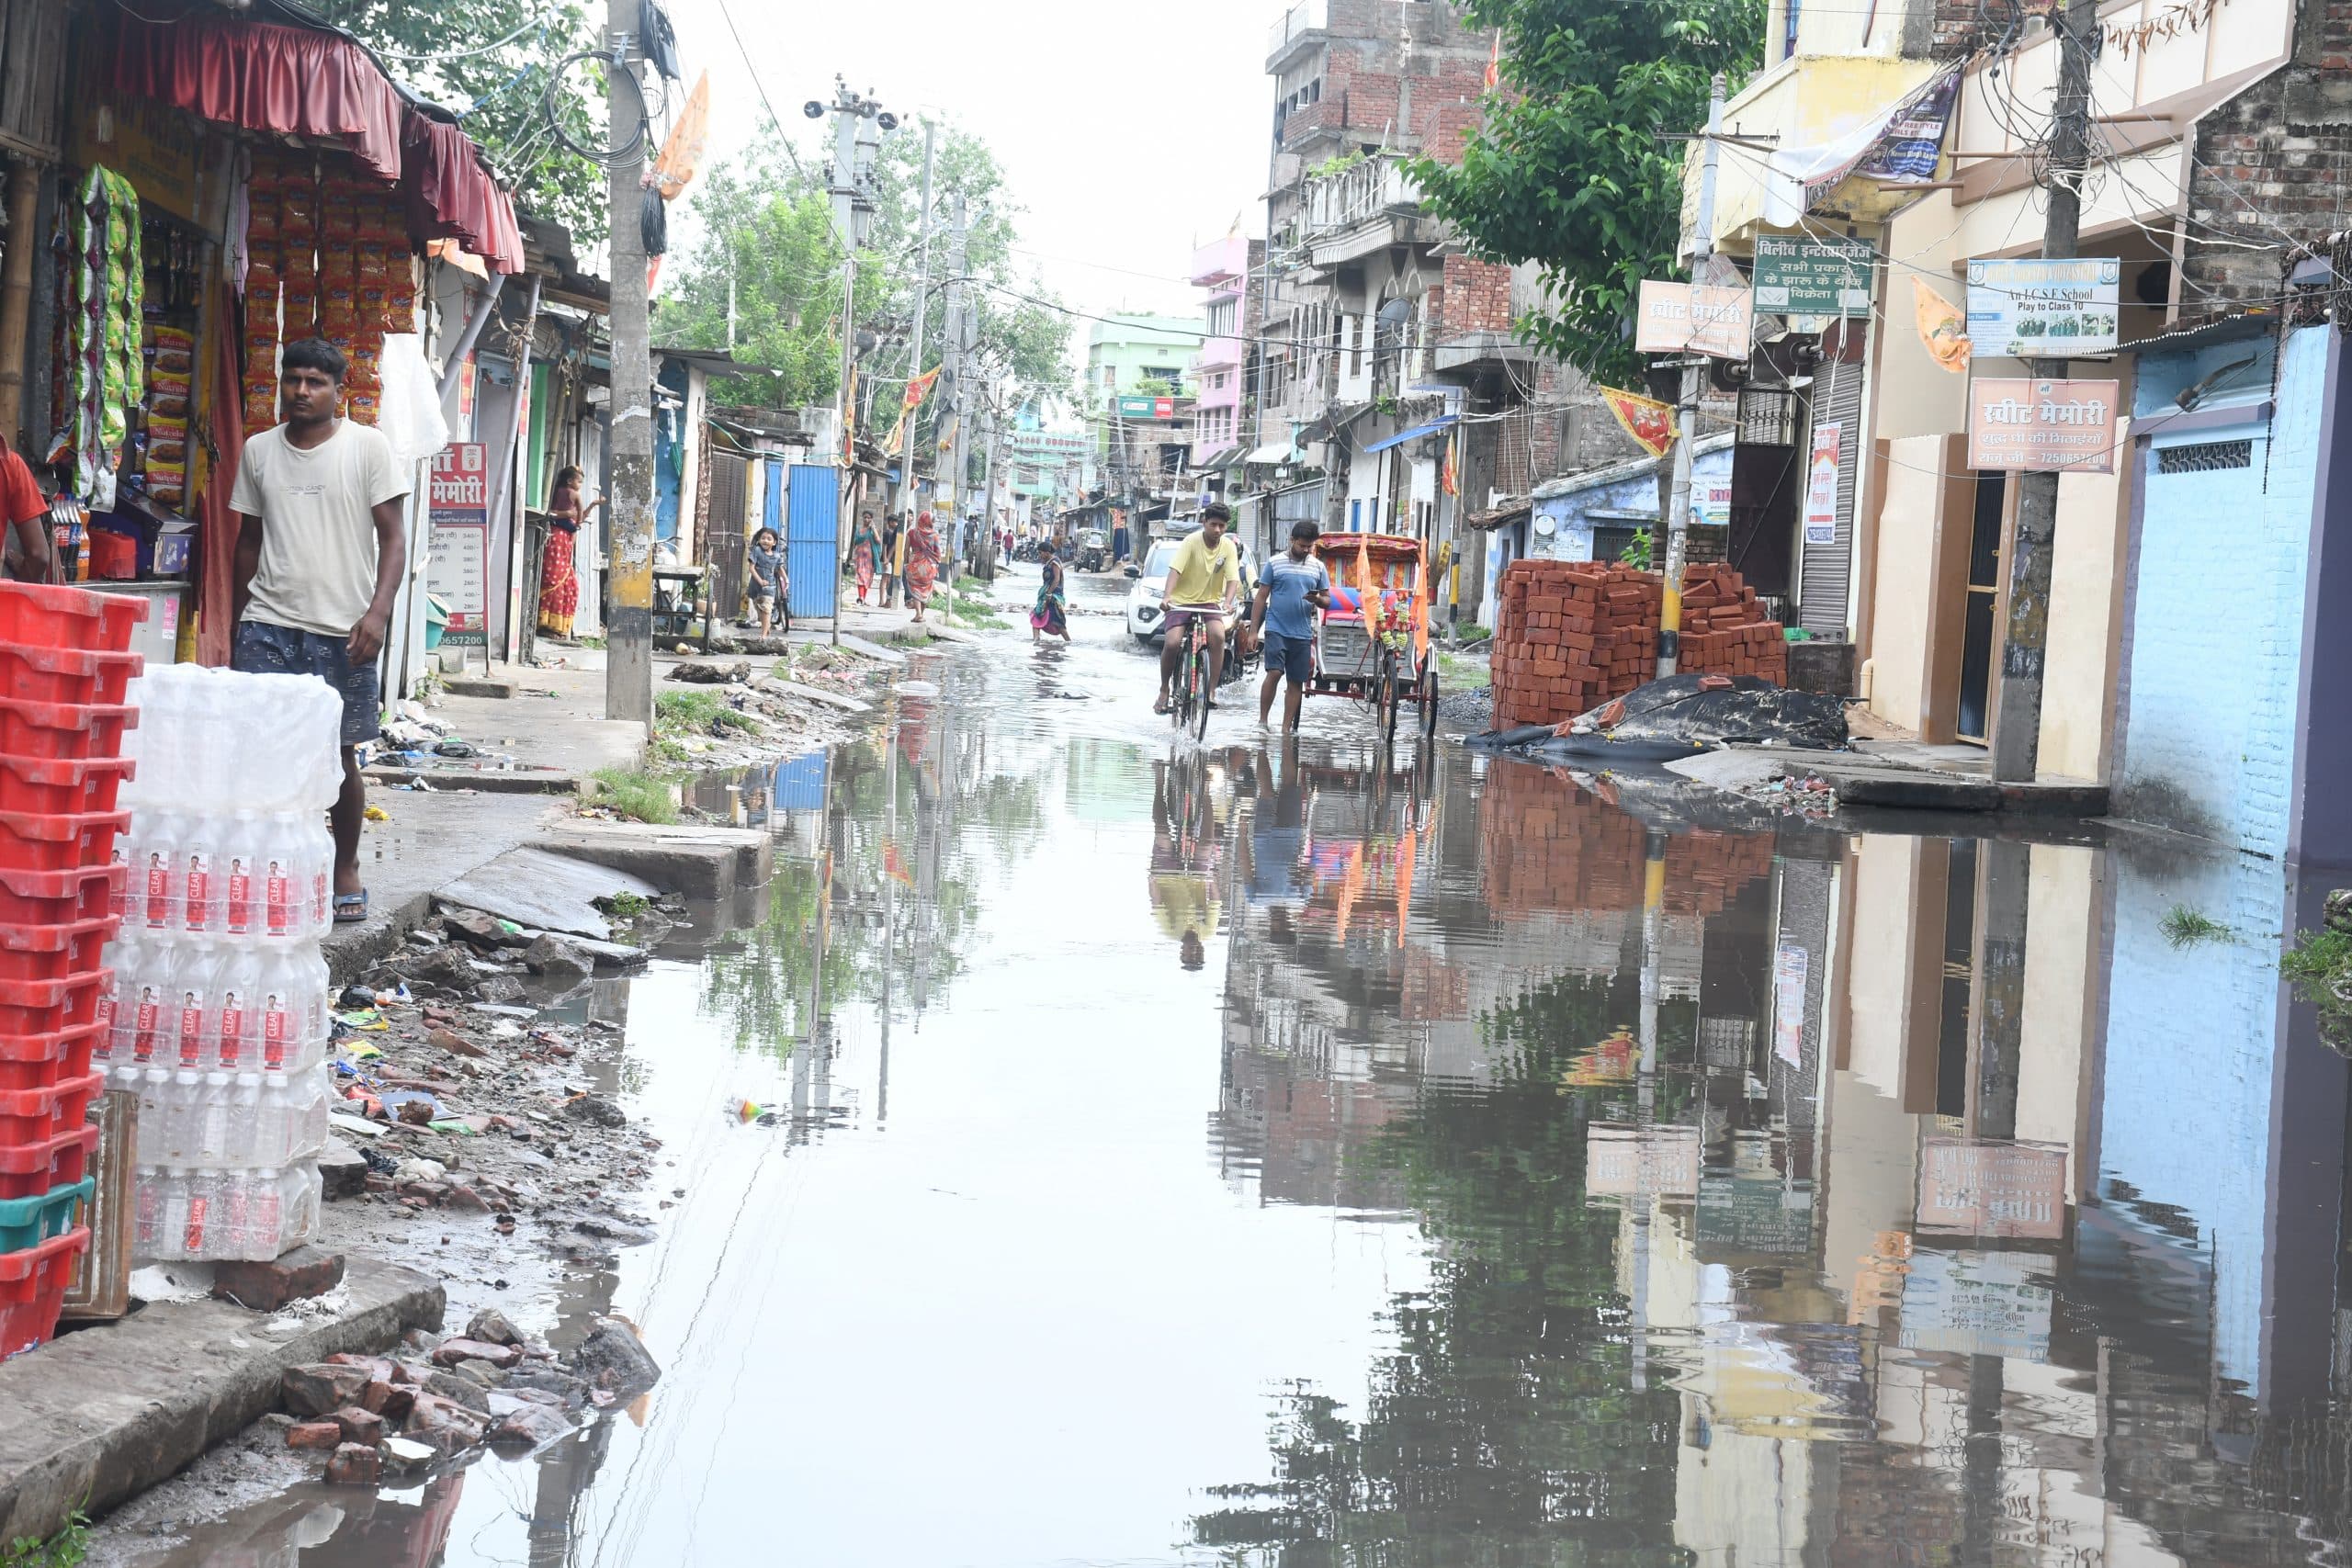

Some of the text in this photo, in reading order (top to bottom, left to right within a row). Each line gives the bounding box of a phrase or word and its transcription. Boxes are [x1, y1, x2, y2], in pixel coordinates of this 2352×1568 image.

[1780, 261, 1849, 273] सभी प्रकार
[1764, 273, 1777, 285] के
[1816, 274, 1829, 286] के
[1791, 287, 1831, 299] विक्रेता
[2061, 288, 2093, 301] School
[2018, 301, 2084, 313] Play to Class 10
[1984, 397, 2108, 425] स्वीट मेमोरी
[154, 426, 184, 438] Nutrela
[2029, 432, 2047, 444] की
[1978, 452, 2004, 466] राजू
[2007, 451, 2024, 463] जी
[2041, 452, 2106, 464] 7250657200
[153, 471, 182, 483] Nutrela
[431, 475, 483, 503] मेमोरी
[151, 870, 161, 895] CLEAR
[190, 873, 200, 897] CLEAR
[232, 875, 242, 901] CLEAR
[269, 878, 279, 903] CLEAR
[140, 1004, 151, 1029] CLEAR
[184, 1009, 194, 1034] CLEAR
[223, 1010, 234, 1034] CLEAR
[267, 1012, 277, 1037] CLEAR
